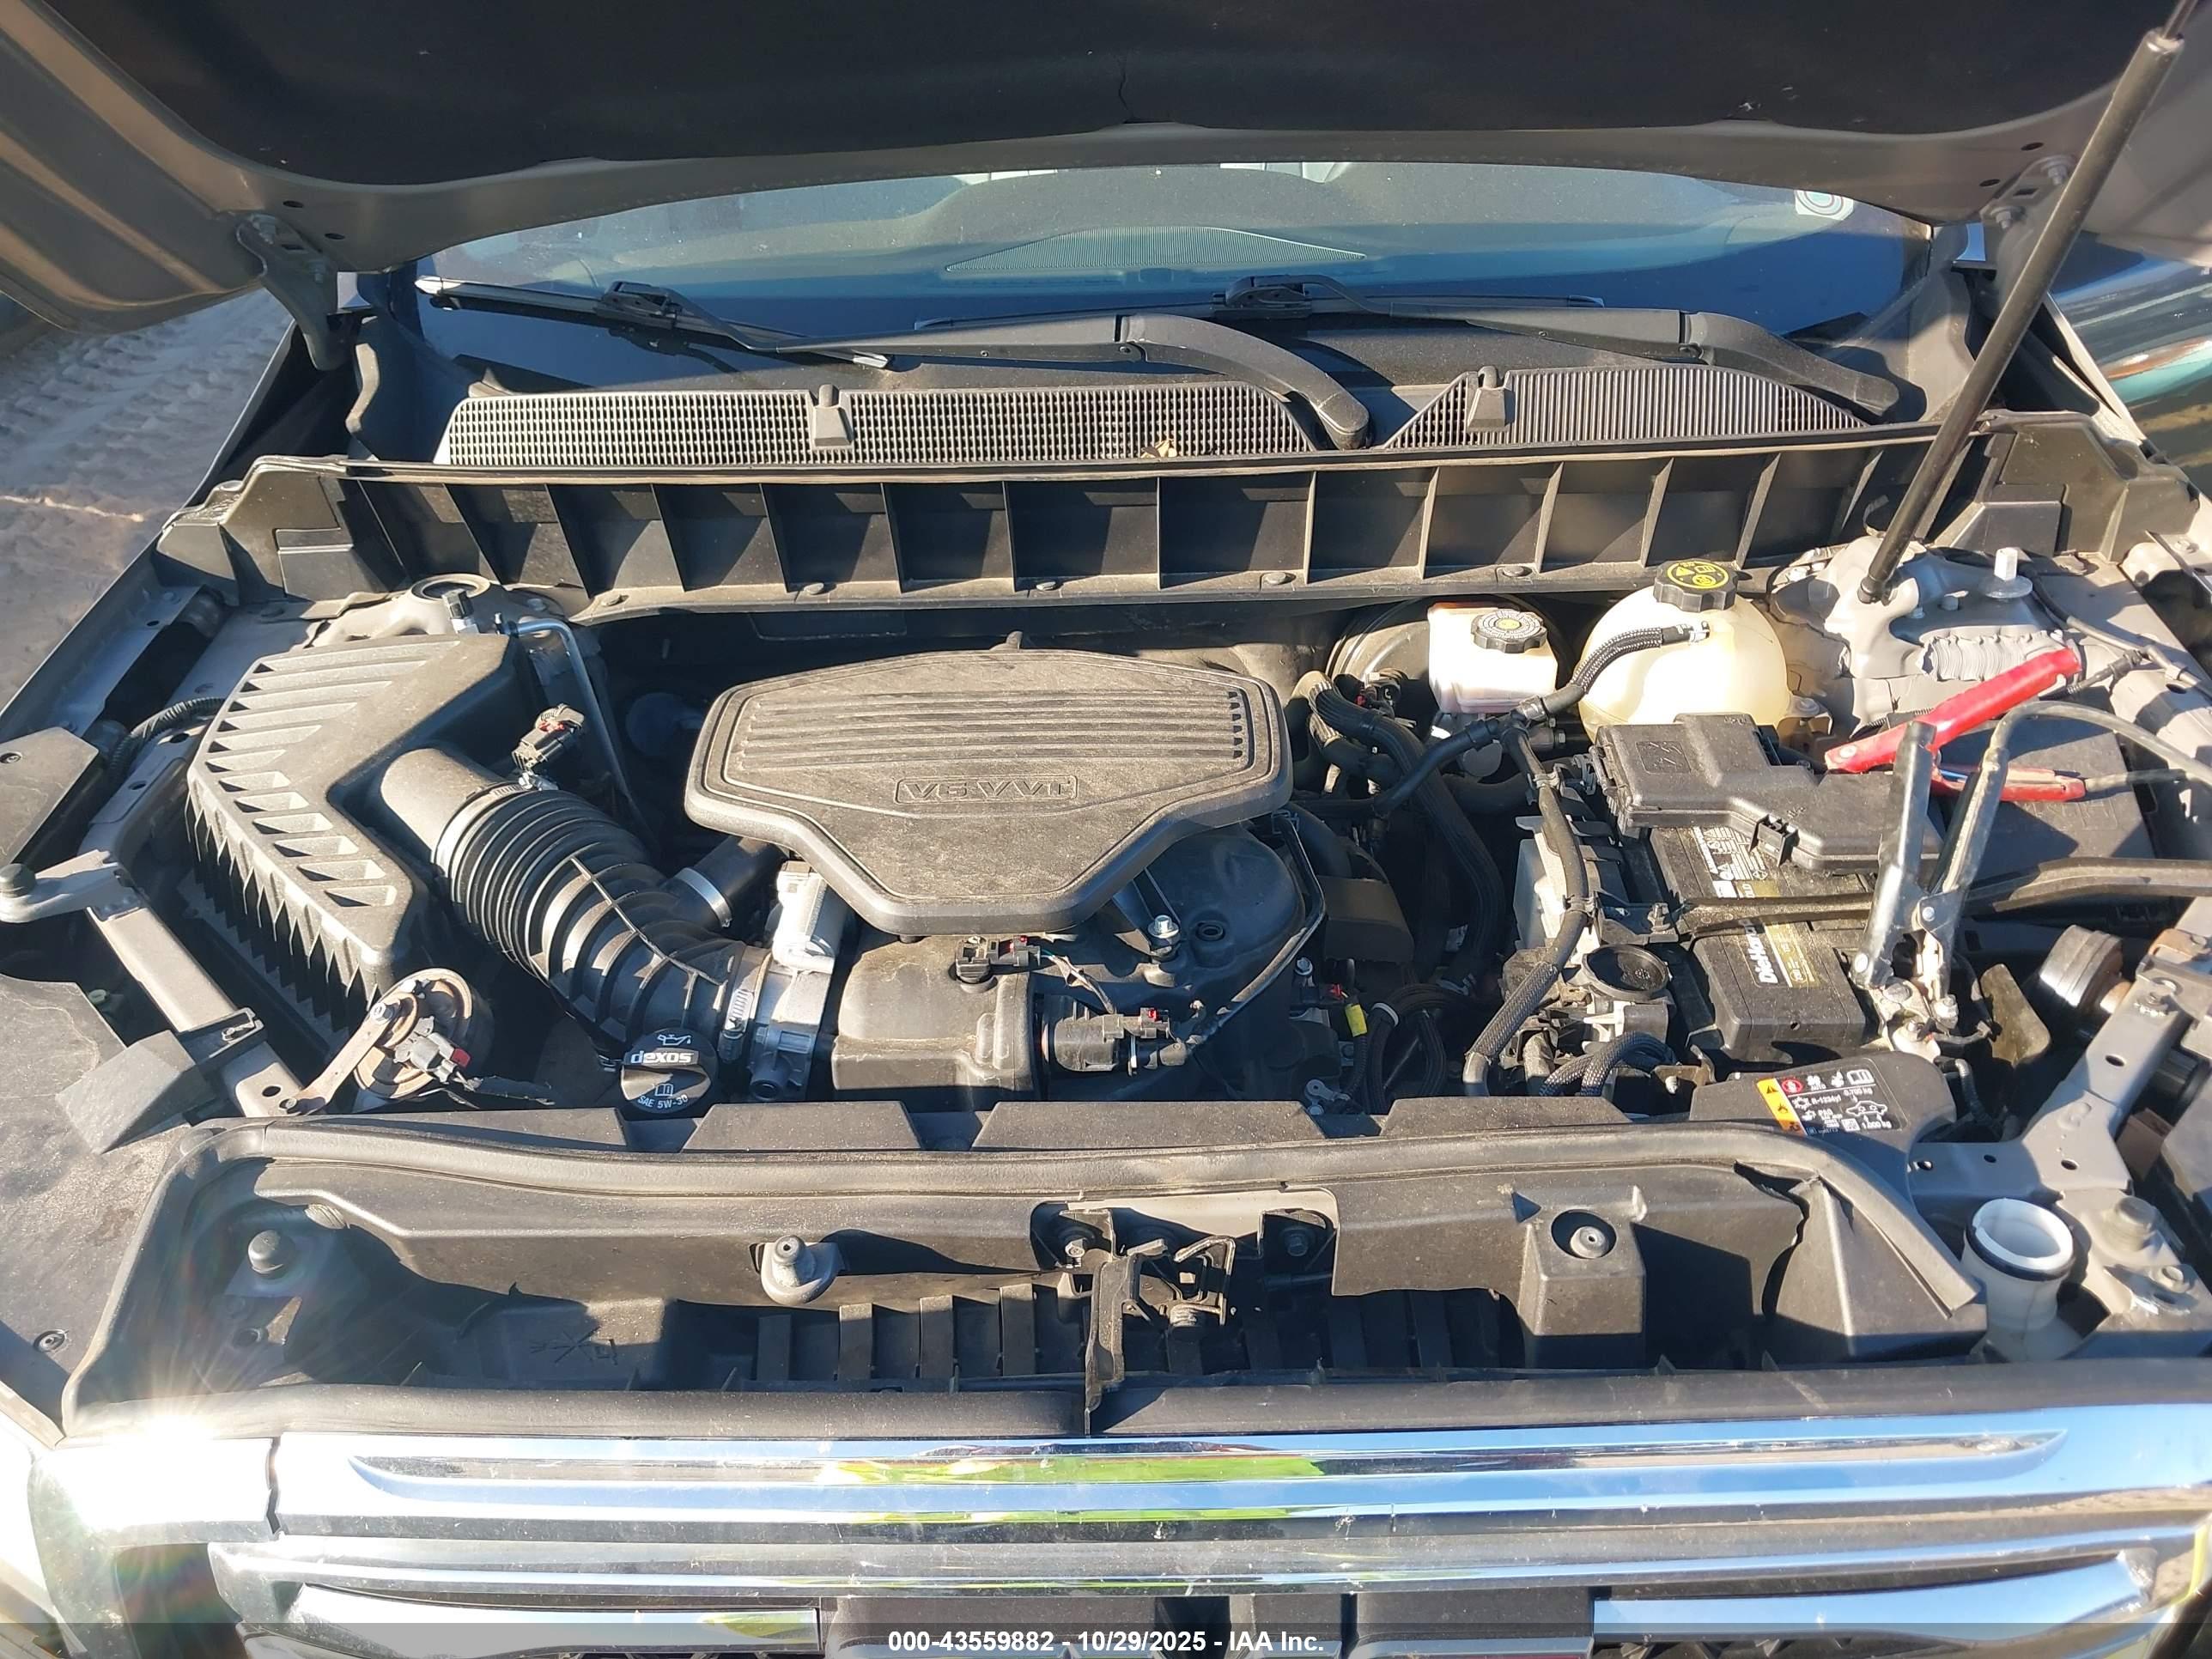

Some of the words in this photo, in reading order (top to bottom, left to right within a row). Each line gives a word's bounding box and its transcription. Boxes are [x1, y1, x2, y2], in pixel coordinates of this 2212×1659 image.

[903, 782, 968, 799] V6
[976, 780, 1072, 799] VVT
[630, 1050, 695, 1064] dexos
[638, 1095, 655, 1108] SAE
[657, 1094, 689, 1109] 5W-30
